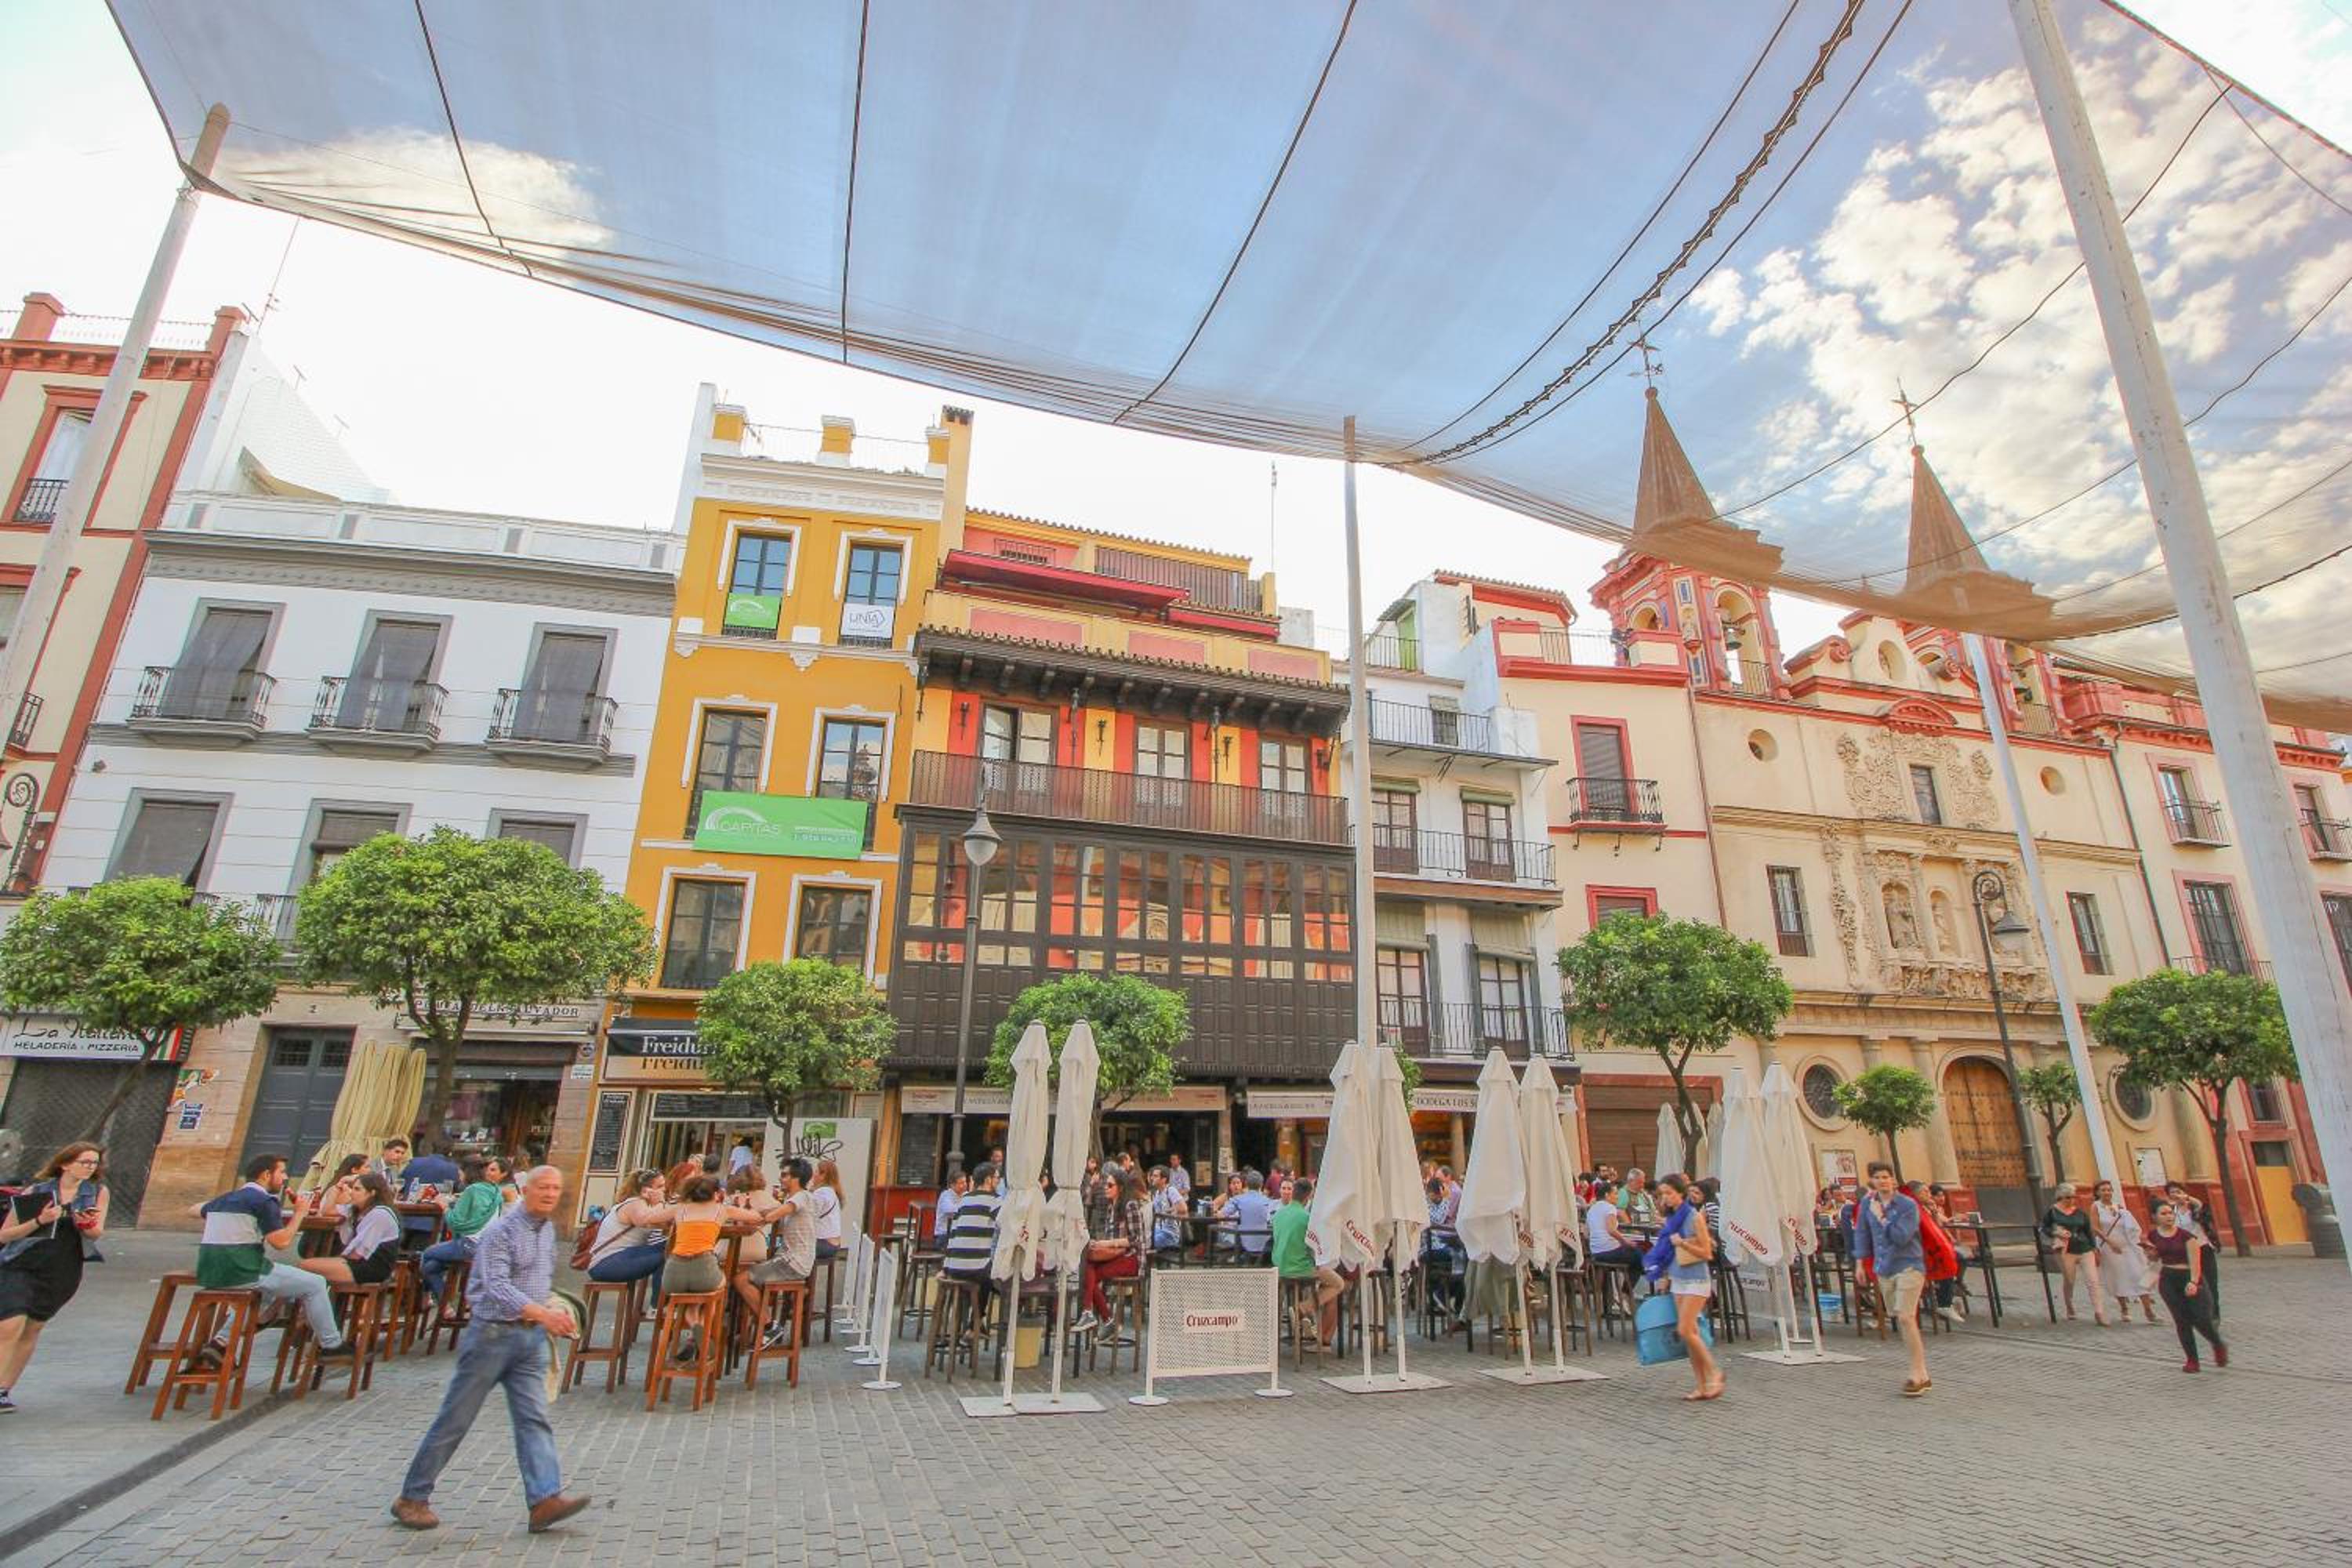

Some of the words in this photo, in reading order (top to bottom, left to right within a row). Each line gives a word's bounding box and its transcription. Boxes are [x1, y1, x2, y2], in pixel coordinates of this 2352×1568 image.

[13, 1018, 58, 1039] La
[1730, 1221, 1769, 1255] ruzcampo
[1186, 1315, 1238, 1328] Cruzcampo
